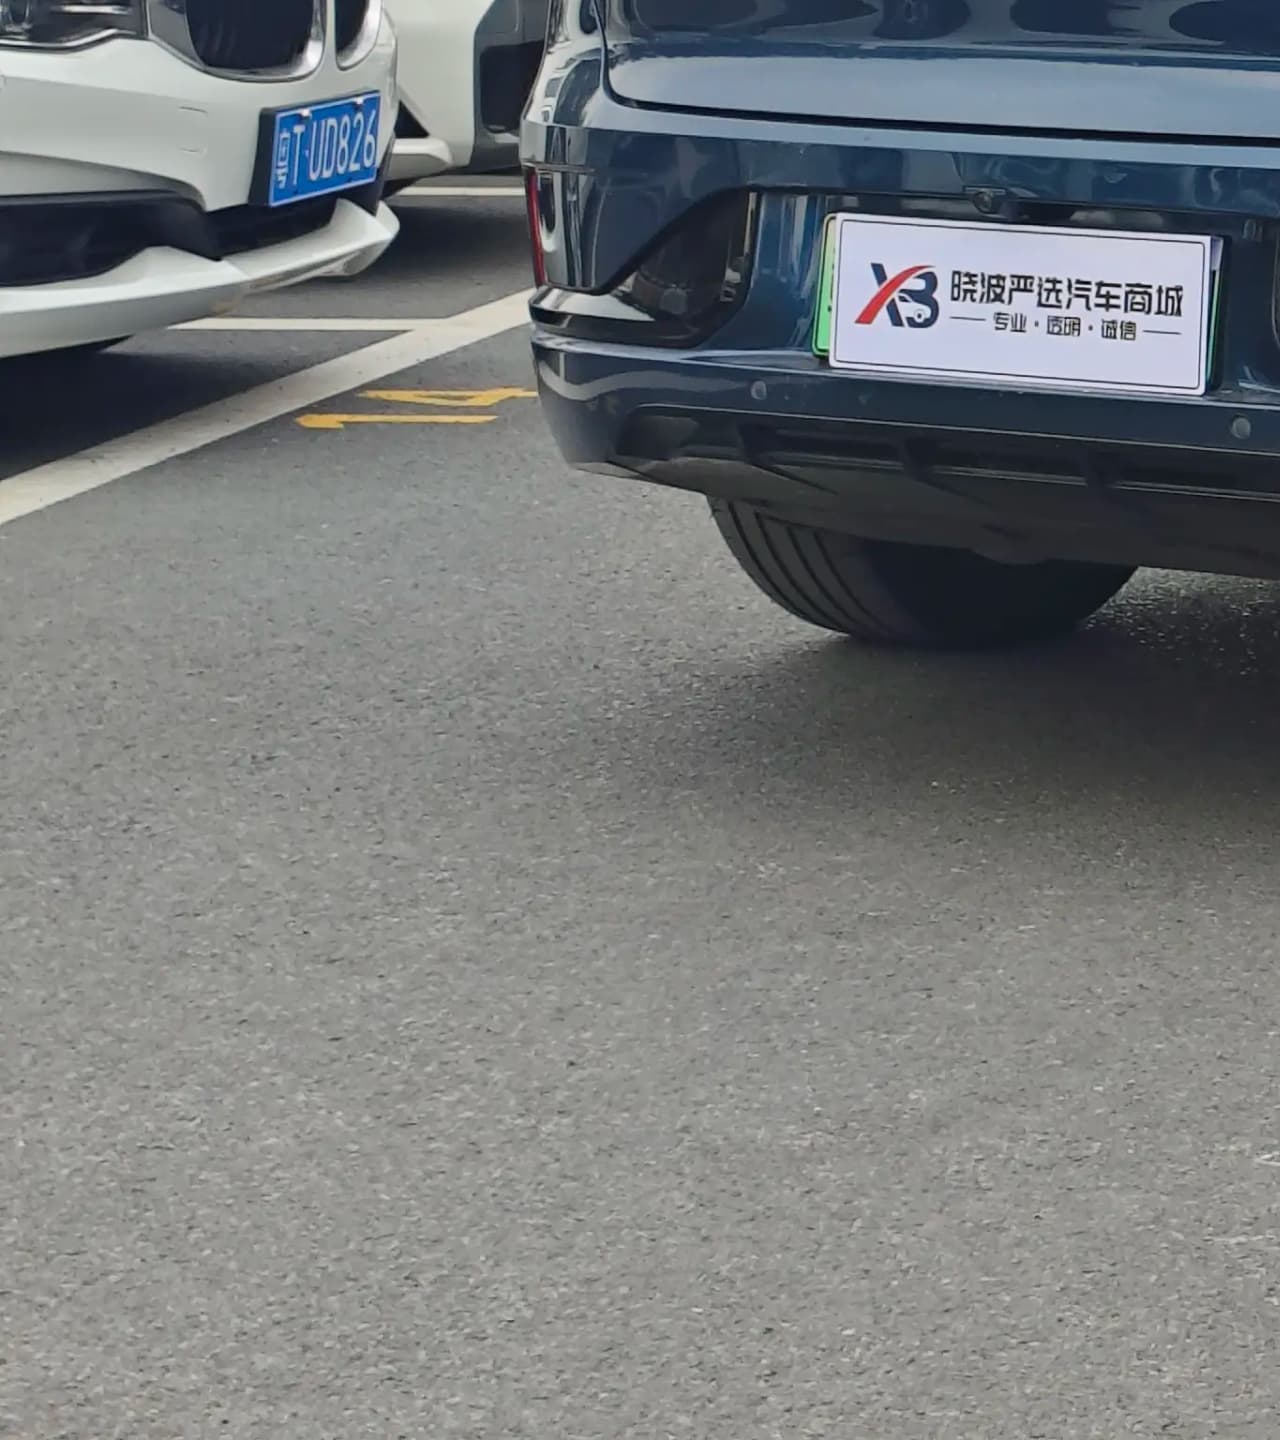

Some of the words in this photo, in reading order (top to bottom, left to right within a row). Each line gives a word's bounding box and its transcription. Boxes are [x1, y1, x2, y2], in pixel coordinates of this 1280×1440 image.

[950, 270, 1183, 317] 晓波严选汽车商城
